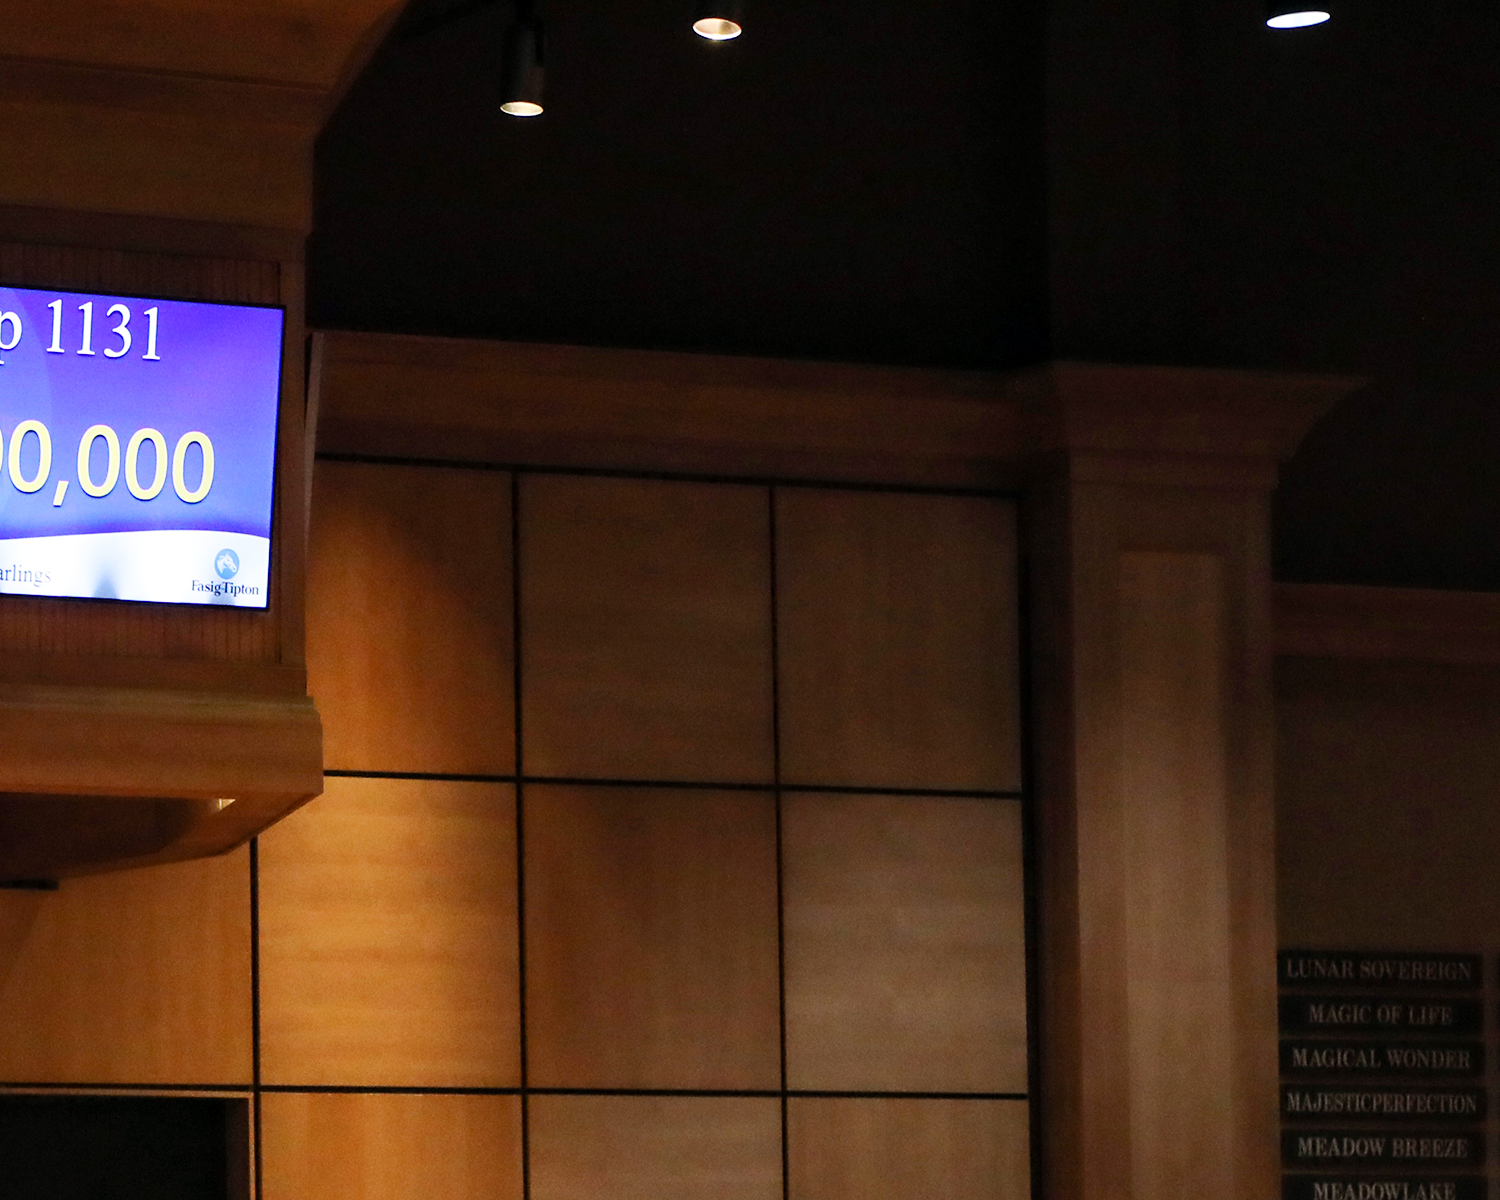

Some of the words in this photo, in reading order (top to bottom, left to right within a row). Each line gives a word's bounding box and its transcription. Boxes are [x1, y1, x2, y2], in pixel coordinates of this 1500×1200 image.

[46, 298, 161, 361] 1131
[191, 579, 260, 598] Fasig-Tipton
[1286, 958, 1355, 979] LUNAR
[1359, 959, 1472, 981] SOVEREIGN
[1308, 1003, 1372, 1024] MAGIC
[1376, 1004, 1401, 1025] OF
[1408, 1005, 1452, 1026] LIFE
[1291, 1047, 1382, 1069] MAGICAL
[1386, 1049, 1471, 1070] WONDER
[1286, 1091, 1478, 1114] MAJESTICPERFECTION
[1297, 1136, 1386, 1158] MEADOW
[1392, 1137, 1469, 1159] BREEZE
